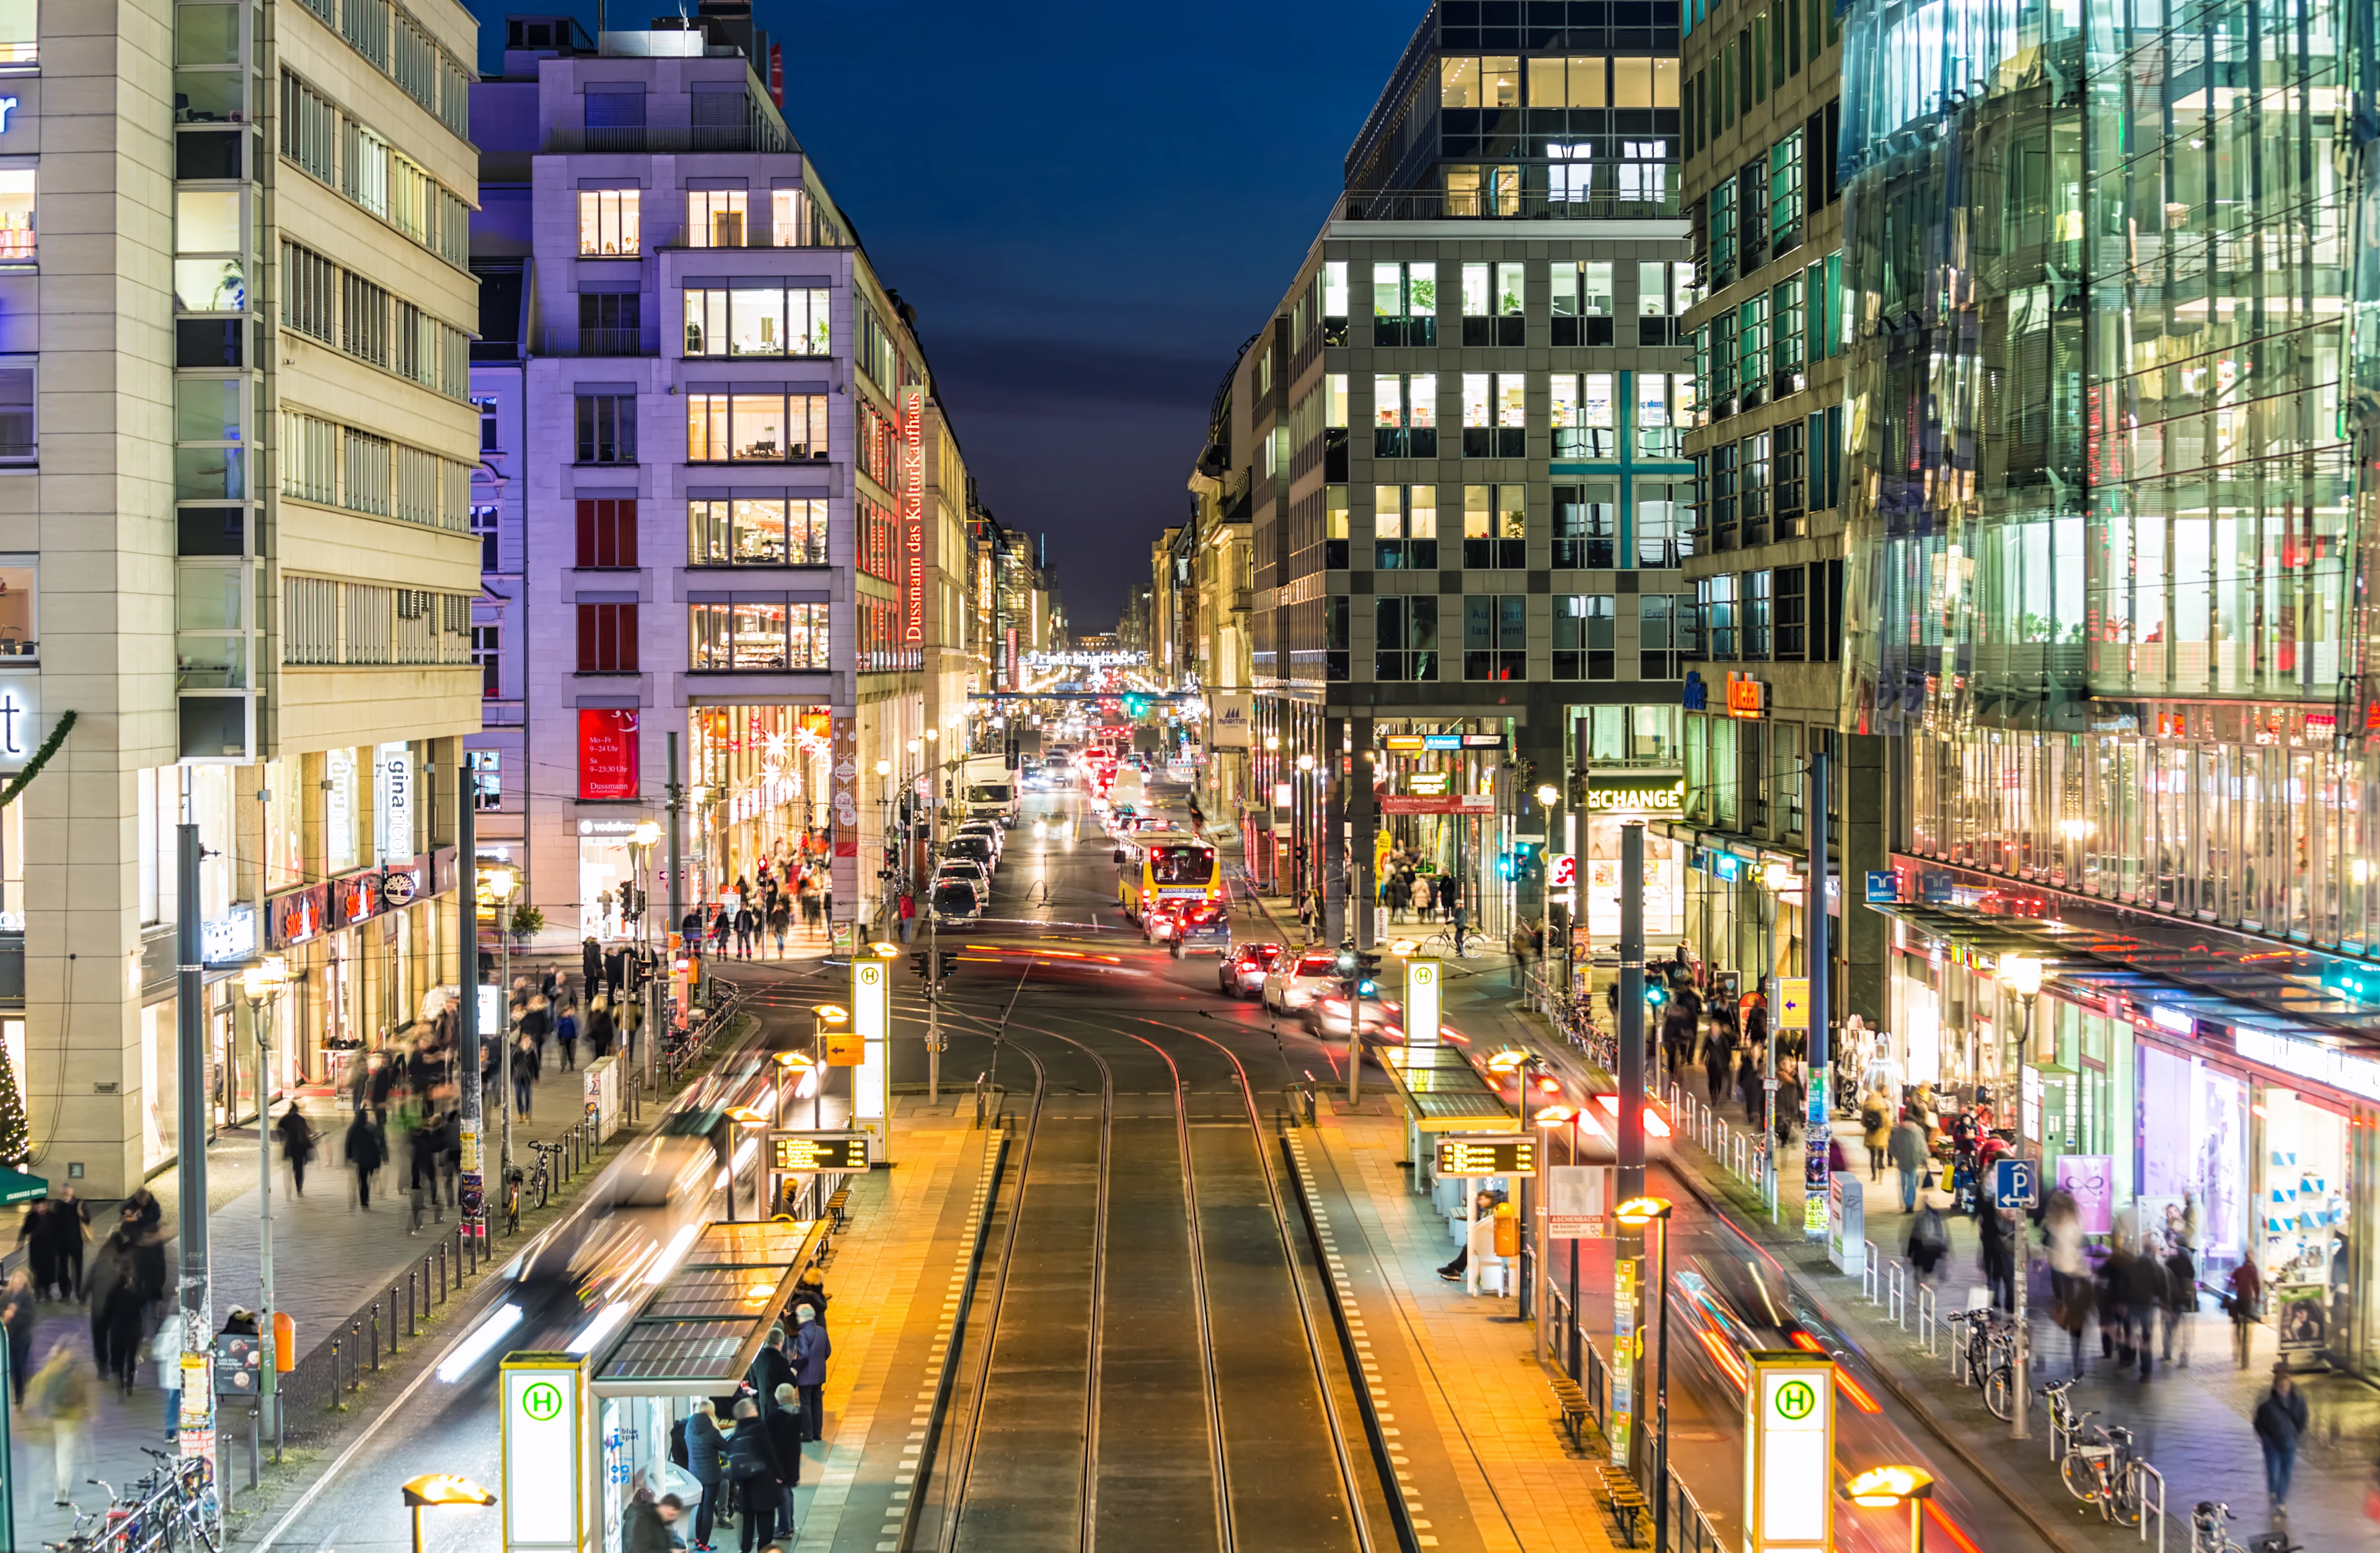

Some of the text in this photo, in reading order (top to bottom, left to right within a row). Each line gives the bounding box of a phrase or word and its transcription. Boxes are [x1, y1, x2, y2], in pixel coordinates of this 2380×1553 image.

[904, 392, 922, 642] Dussmann das KulturKaufhaus
[1644, 609, 1696, 619] Expres
[593, 820, 637, 832] vodafone
[2013, 1171, 2028, 1197] P
[6, 1187, 47, 1200] STARBUCKS COFFEE
[622, 1434, 639, 1442] spot
